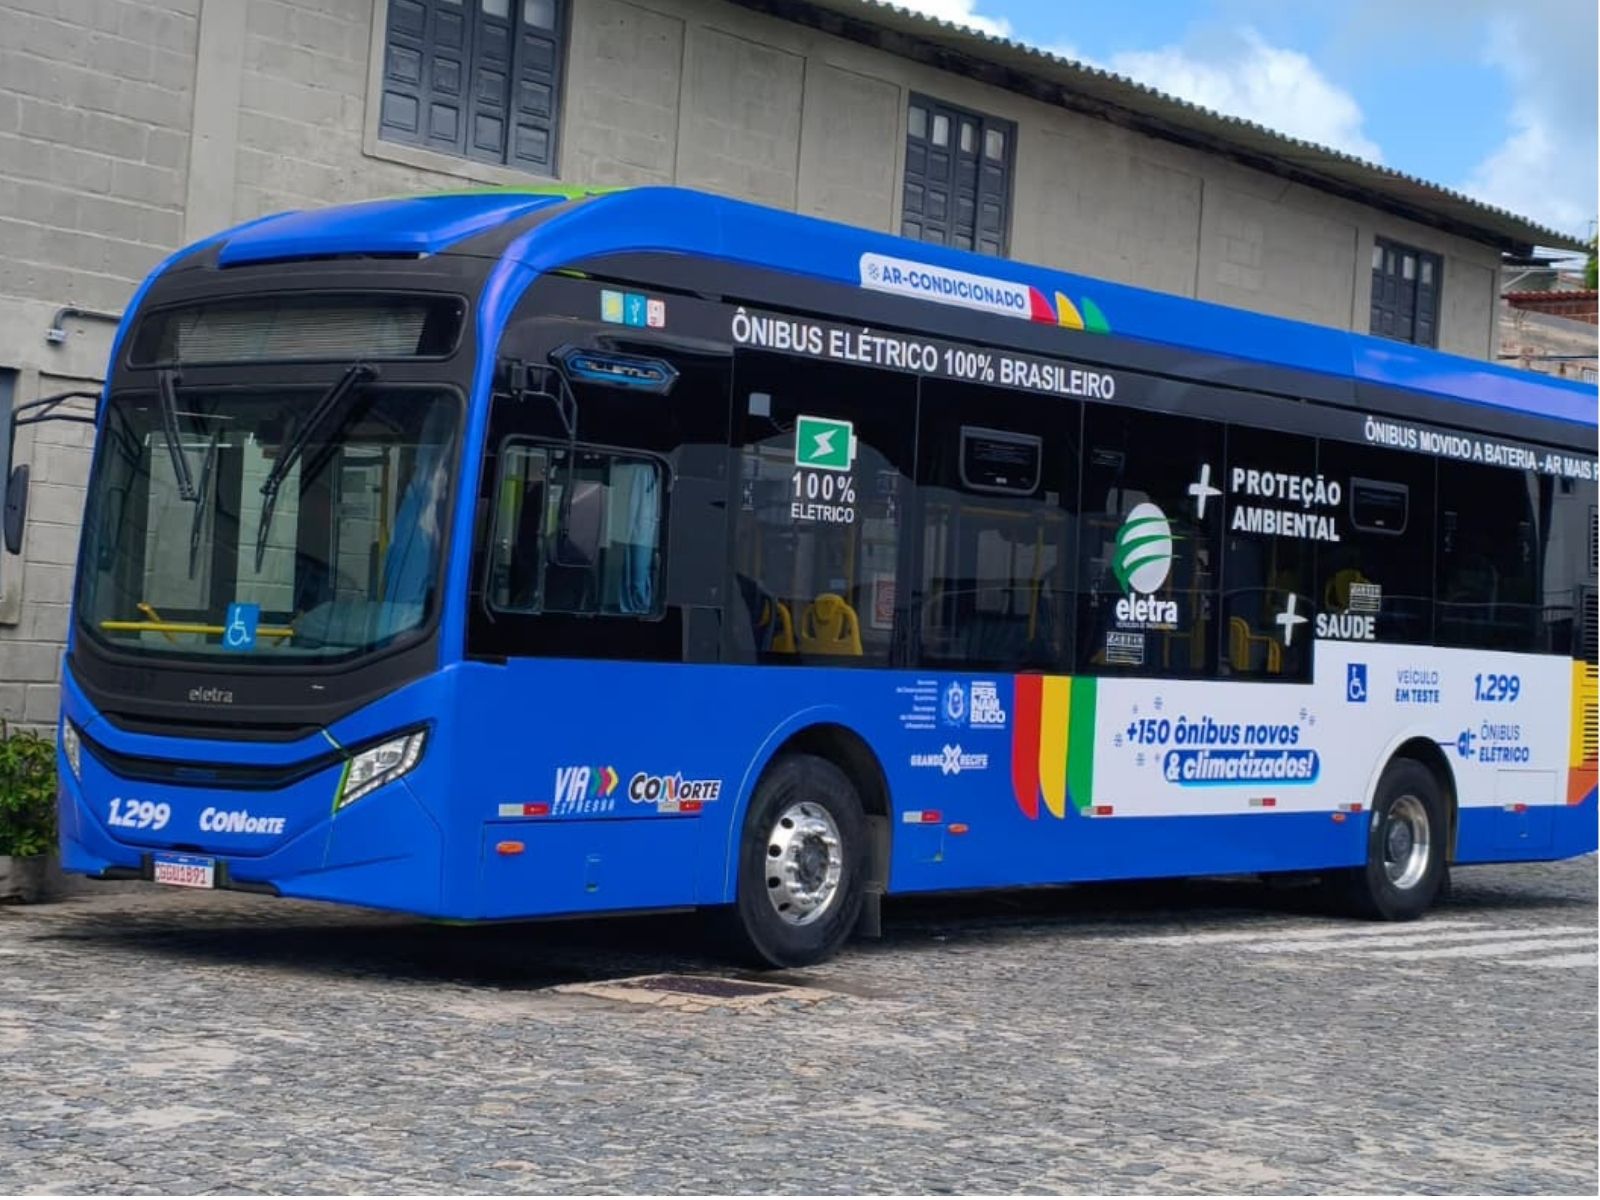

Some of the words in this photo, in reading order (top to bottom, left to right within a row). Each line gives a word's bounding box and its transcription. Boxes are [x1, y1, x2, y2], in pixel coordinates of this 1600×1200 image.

[882, 265, 1025, 309] AR-CONDICIONADO
[732, 306, 823, 354] ÔNIBUS
[829, 328, 938, 373] ELÉTRICO
[944, 349, 995, 383] 100%
[1000, 358, 1115, 400] BRASILEIRO
[1365, 416, 1417, 449] ÔNIBUS
[1420, 431, 1471, 459] MOVIDO
[1473, 443, 1483, 461] A
[1485, 444, 1537, 471] BATERIA
[1544, 454, 1562, 474] AR
[1564, 457, 1592, 479] MAIS
[792, 471, 855, 503] 100%
[1232, 467, 1341, 508] PROTEÇÃO
[791, 502, 855, 523] ELETRICO
[1232, 505, 1340, 542] AMBIENTAL
[1116, 592, 1178, 622] eletra
[1316, 609, 1376, 639] SAÚDE
[1397, 667, 1438, 685] VEÍCULO
[1474, 673, 1520, 702] 1.299
[188, 686, 233, 703] eletra
[1395, 688, 1410, 702] EM
[1412, 689, 1439, 703] TESTE
[1126, 719, 1171, 744] +150
[1174, 715, 1240, 745] ônibus
[1244, 723, 1299, 745] novos
[1480, 719, 1520, 741] ÔNIBUS
[1183, 750, 1315, 780] climatizados!
[1479, 743, 1529, 763] ELÉTRICO
[554, 766, 591, 802] VIA
[108, 798, 171, 830] 1.299
